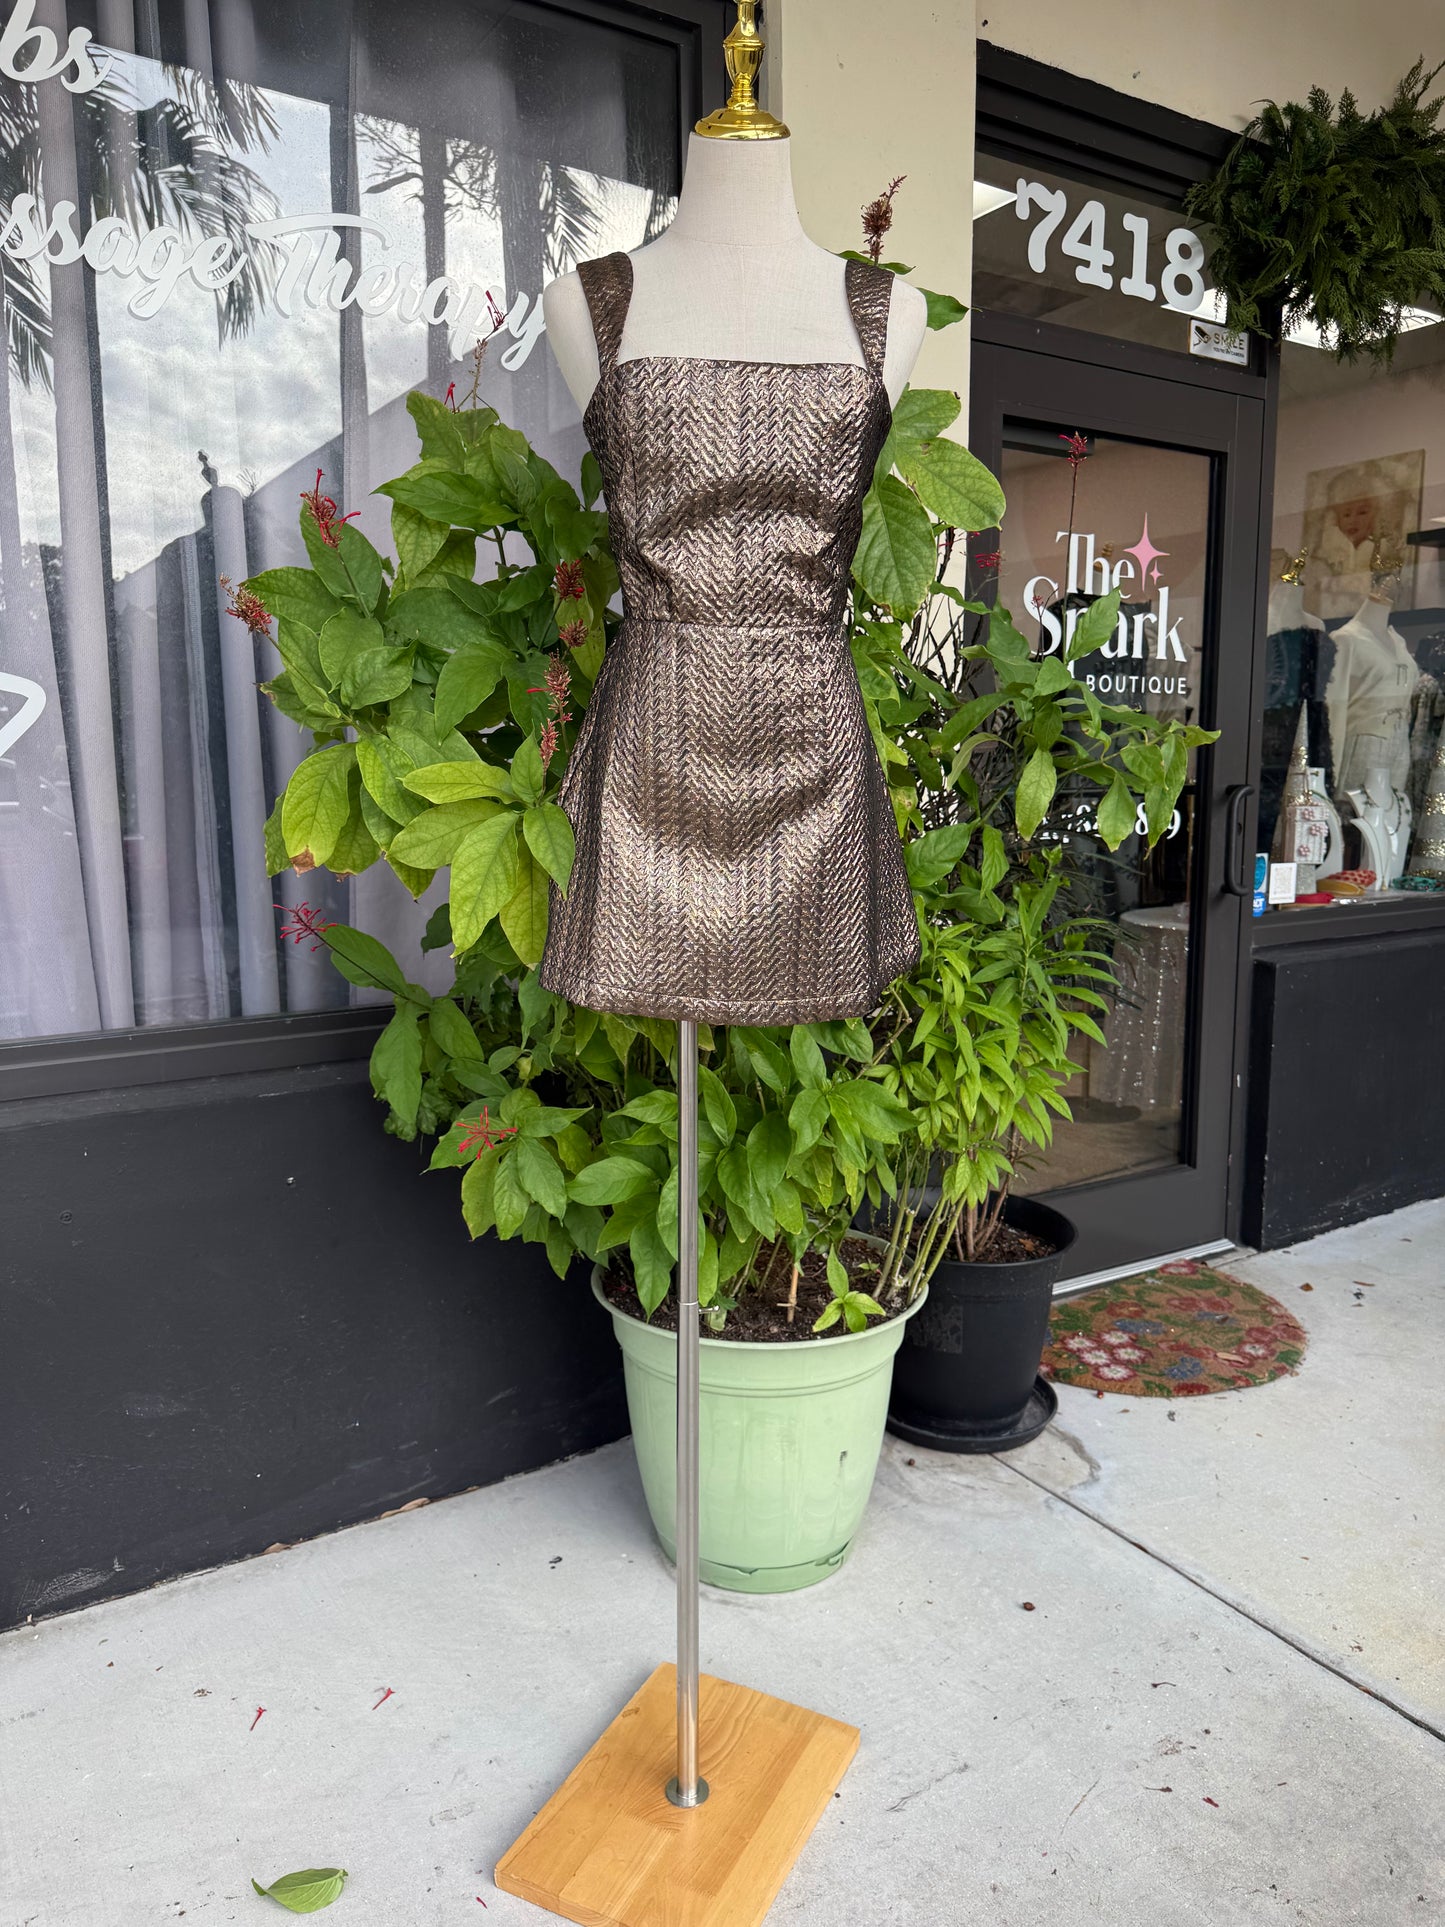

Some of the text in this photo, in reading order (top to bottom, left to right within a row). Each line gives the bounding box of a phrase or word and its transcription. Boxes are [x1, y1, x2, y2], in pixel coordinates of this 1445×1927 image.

[1015, 178, 1206, 312] 7418
[0, 193, 547, 372] ssage Therapy
[1213, 332, 1245, 350] SMLE
[1055, 531, 1135, 599] The
[1086, 674, 1188, 695] BOUTIQUE
